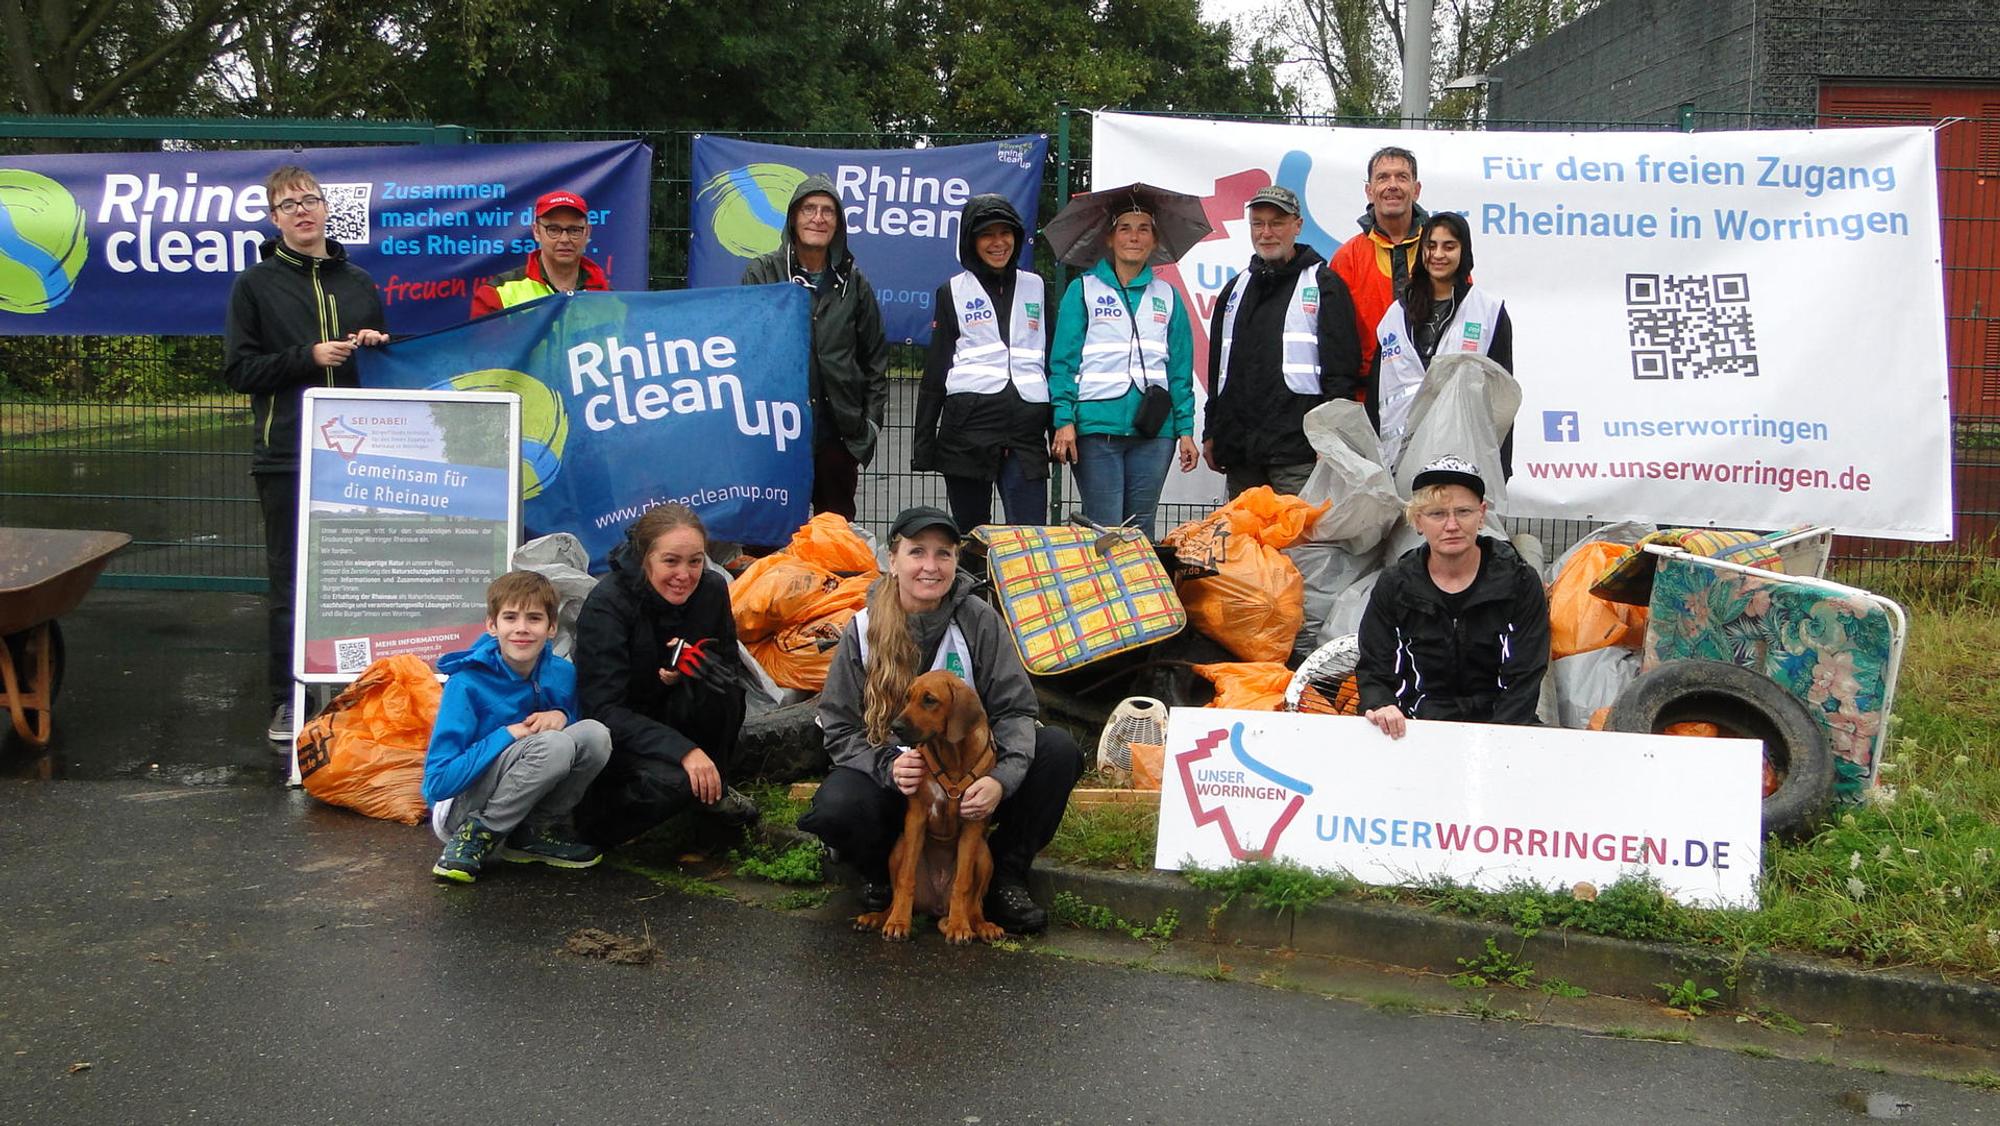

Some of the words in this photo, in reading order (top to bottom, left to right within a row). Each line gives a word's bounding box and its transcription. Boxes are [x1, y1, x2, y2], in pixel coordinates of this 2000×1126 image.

[836, 165, 970, 206] Rhine
[1482, 155, 1543, 181] Für
[1556, 155, 1624, 183] den
[1636, 154, 1744, 186] freien
[1757, 156, 1896, 197] Zugang
[97, 172, 269, 223] Rhine
[382, 181, 506, 201] Zusammen
[381, 208, 475, 228] machen
[475, 207, 513, 227] wir
[844, 194, 962, 239] clean
[1482, 202, 1657, 239] Rheinaue
[1670, 206, 1700, 239] in
[1714, 206, 1908, 242] Worringen
[106, 214, 266, 273] clean
[381, 235, 420, 256] des
[428, 234, 504, 255] Rheins
[384, 275, 466, 306] freuen
[965, 309, 992, 323] PRO
[1094, 308, 1122, 318] PRO
[567, 331, 737, 396] Rhine
[1382, 345, 1401, 360] PRO
[352, 416, 368, 426] SEI
[371, 416, 408, 426] DABEI!
[1603, 413, 1828, 444] unserworringen
[347, 460, 438, 485] Gemeinsam
[443, 470, 468, 488] für
[1527, 458, 1871, 493] www.unserworringen.de
[344, 484, 369, 500] die
[375, 486, 450, 509] Rheinaue
[398, 633, 460, 646] INFORMATIONEN
[1198, 769, 1245, 784] UNSER
[1197, 783, 1287, 801] WORRINGEN
[1316, 813, 1731, 870] UNSERWORRINGEN.DE
